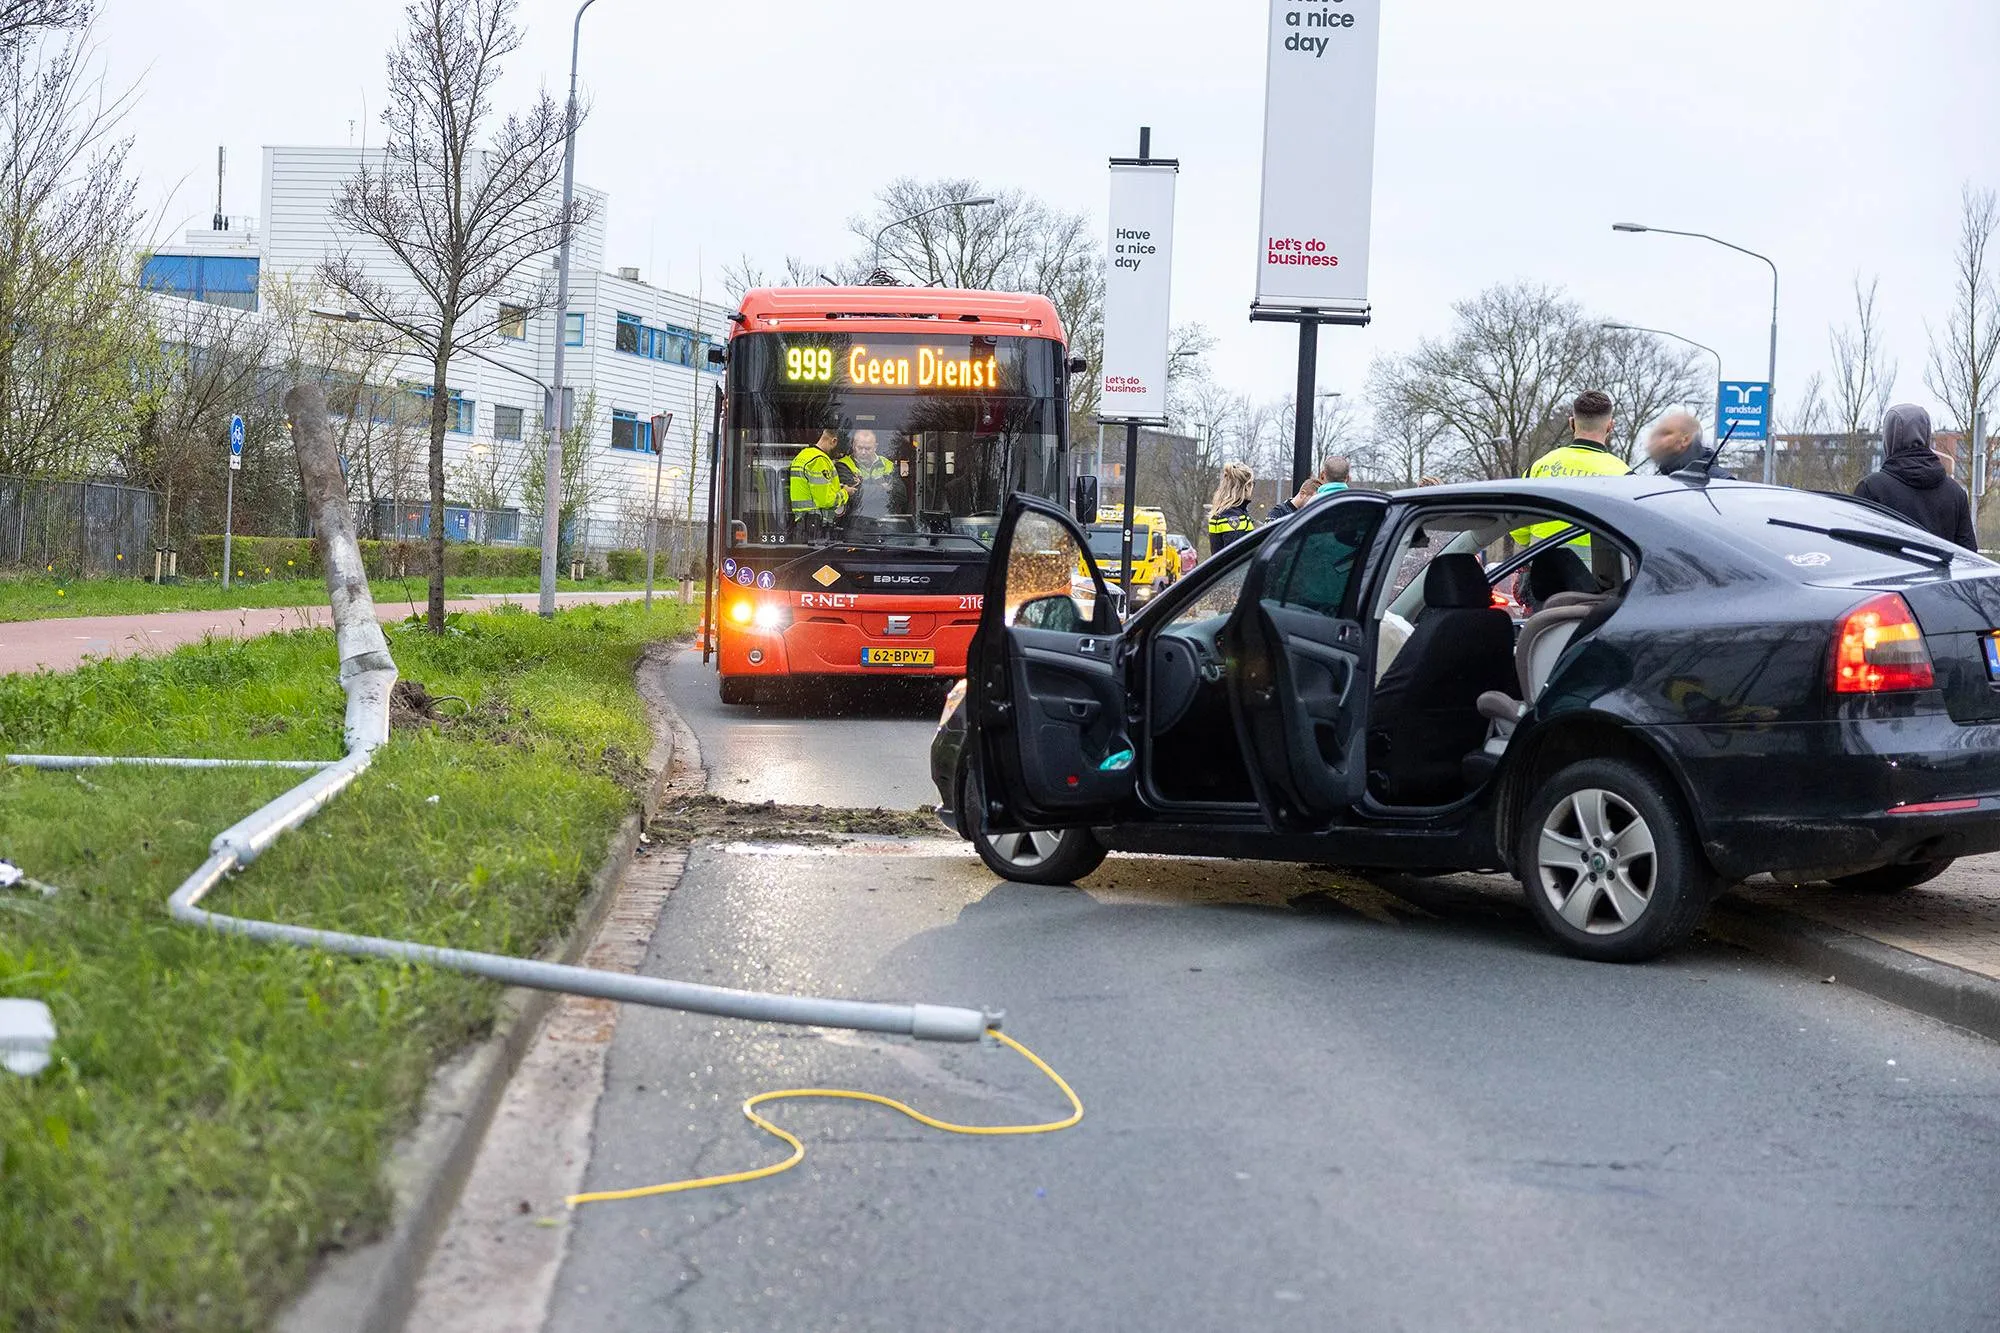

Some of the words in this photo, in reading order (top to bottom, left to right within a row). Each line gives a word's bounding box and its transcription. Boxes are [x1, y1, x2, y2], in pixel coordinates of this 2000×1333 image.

[1286, 11, 1301, 27] a
[1307, 7, 1355, 28] nice
[1284, 32, 1330, 58] day
[1116, 228, 1151, 240] Have
[1115, 244, 1124, 253] a
[1128, 242, 1156, 254] nice
[1304, 238, 1326, 252] do
[1114, 256, 1142, 272] day
[1268, 250, 1338, 267] business
[787, 346, 832, 381] 999
[849, 345, 910, 386] Geen
[918, 347, 998, 388] Dienst
[1126, 376, 1140, 385] do
[1105, 383, 1147, 393] business
[1724, 404, 1762, 415] randstad
[761, 535, 785, 543] 338
[873, 575, 931, 584] EBUSCO
[959, 596, 984, 609] 2116
[873, 650, 930, 662] 62-BPV-7
